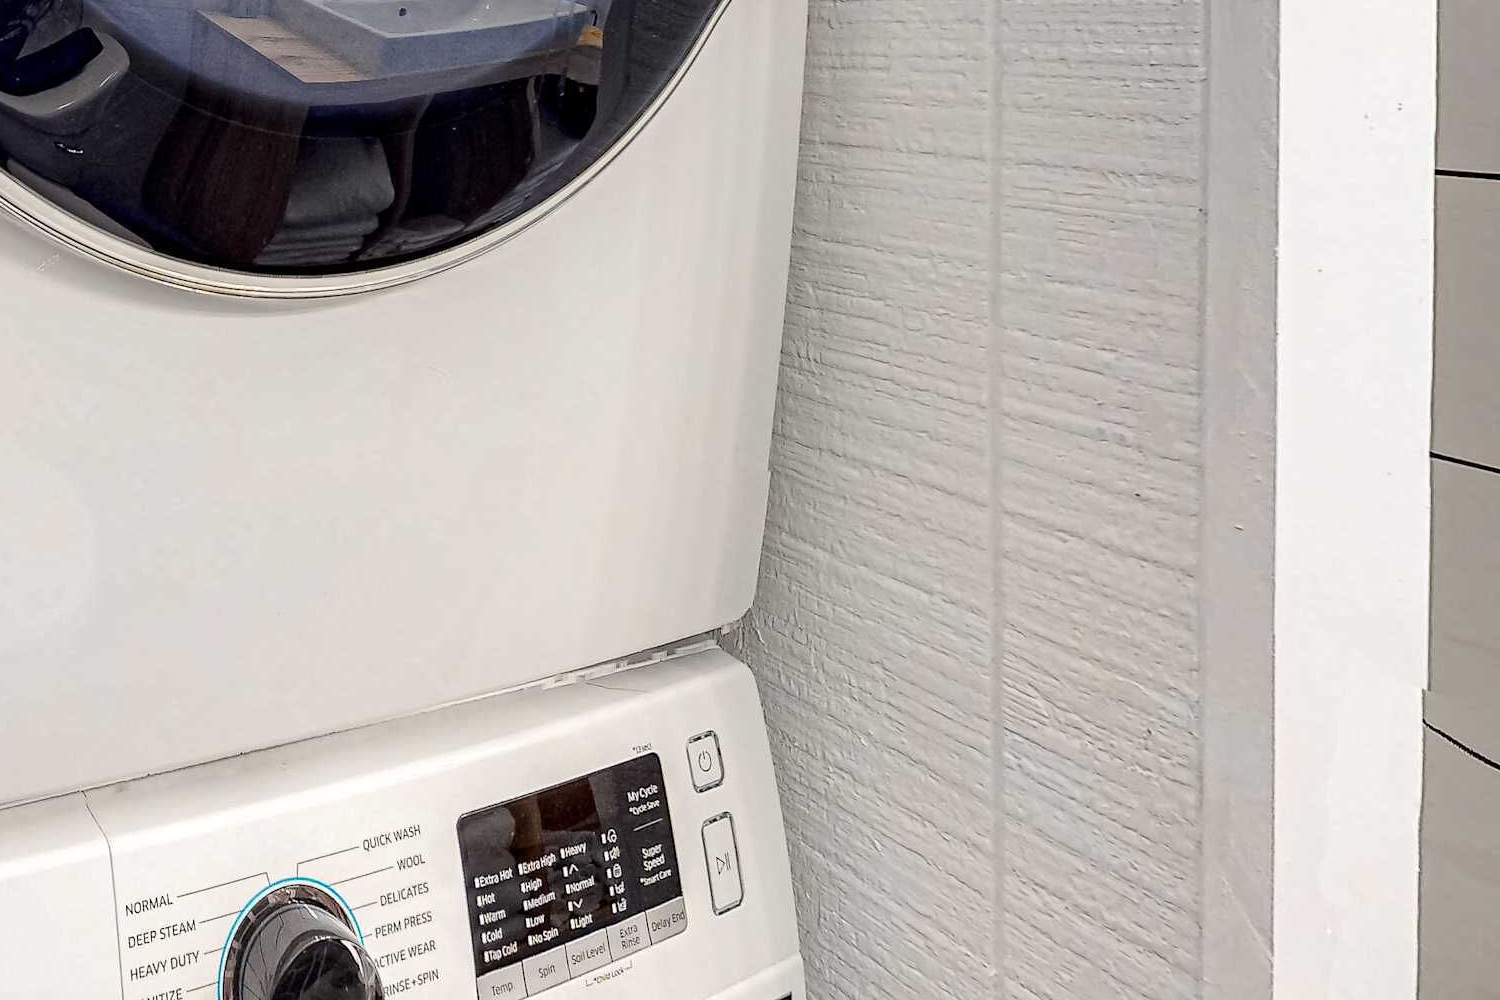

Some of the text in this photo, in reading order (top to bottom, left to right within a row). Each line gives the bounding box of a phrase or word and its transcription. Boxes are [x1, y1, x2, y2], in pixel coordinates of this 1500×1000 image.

[627, 784, 658, 802] My Cycle
[647, 799, 660, 810] Save
[362, 824, 421, 851] QUICK WASH
[565, 842, 586, 857] Heavy
[641, 843, 662, 859] Super
[397, 854, 426, 870] WOOL
[522, 853, 556, 875] Extra High
[643, 853, 665, 871] Speed
[479, 868, 513, 888] Extra Hot
[659, 868, 672, 879] Care
[525, 878, 542, 892] High
[570, 875, 595, 892] Normal
[379, 882, 429, 907] DELICATES
[481, 893, 496, 905] Hot
[527, 891, 556, 910] Medium
[125, 893, 173, 917] NORMAL
[375, 911, 433, 939] PERM PRESS
[484, 909, 506, 925] Warm
[529, 914, 545, 928] Low
[574, 913, 593, 928] Light
[651, 911, 686, 933] Delay End
[128, 919, 196, 949] DEEP STEAM
[486, 928, 503, 943] Cold
[532, 927, 559, 945] No Spin
[619, 923, 638, 938] Extra
[408, 939, 436, 958] WEAR
[489, 941, 518, 962] Tap Cold
[621, 936, 641, 951] Rinse
[571, 943, 606, 966] Soil Level
[130, 950, 200, 981] HEAVY DUTY
[539, 965, 555, 979] Spin
